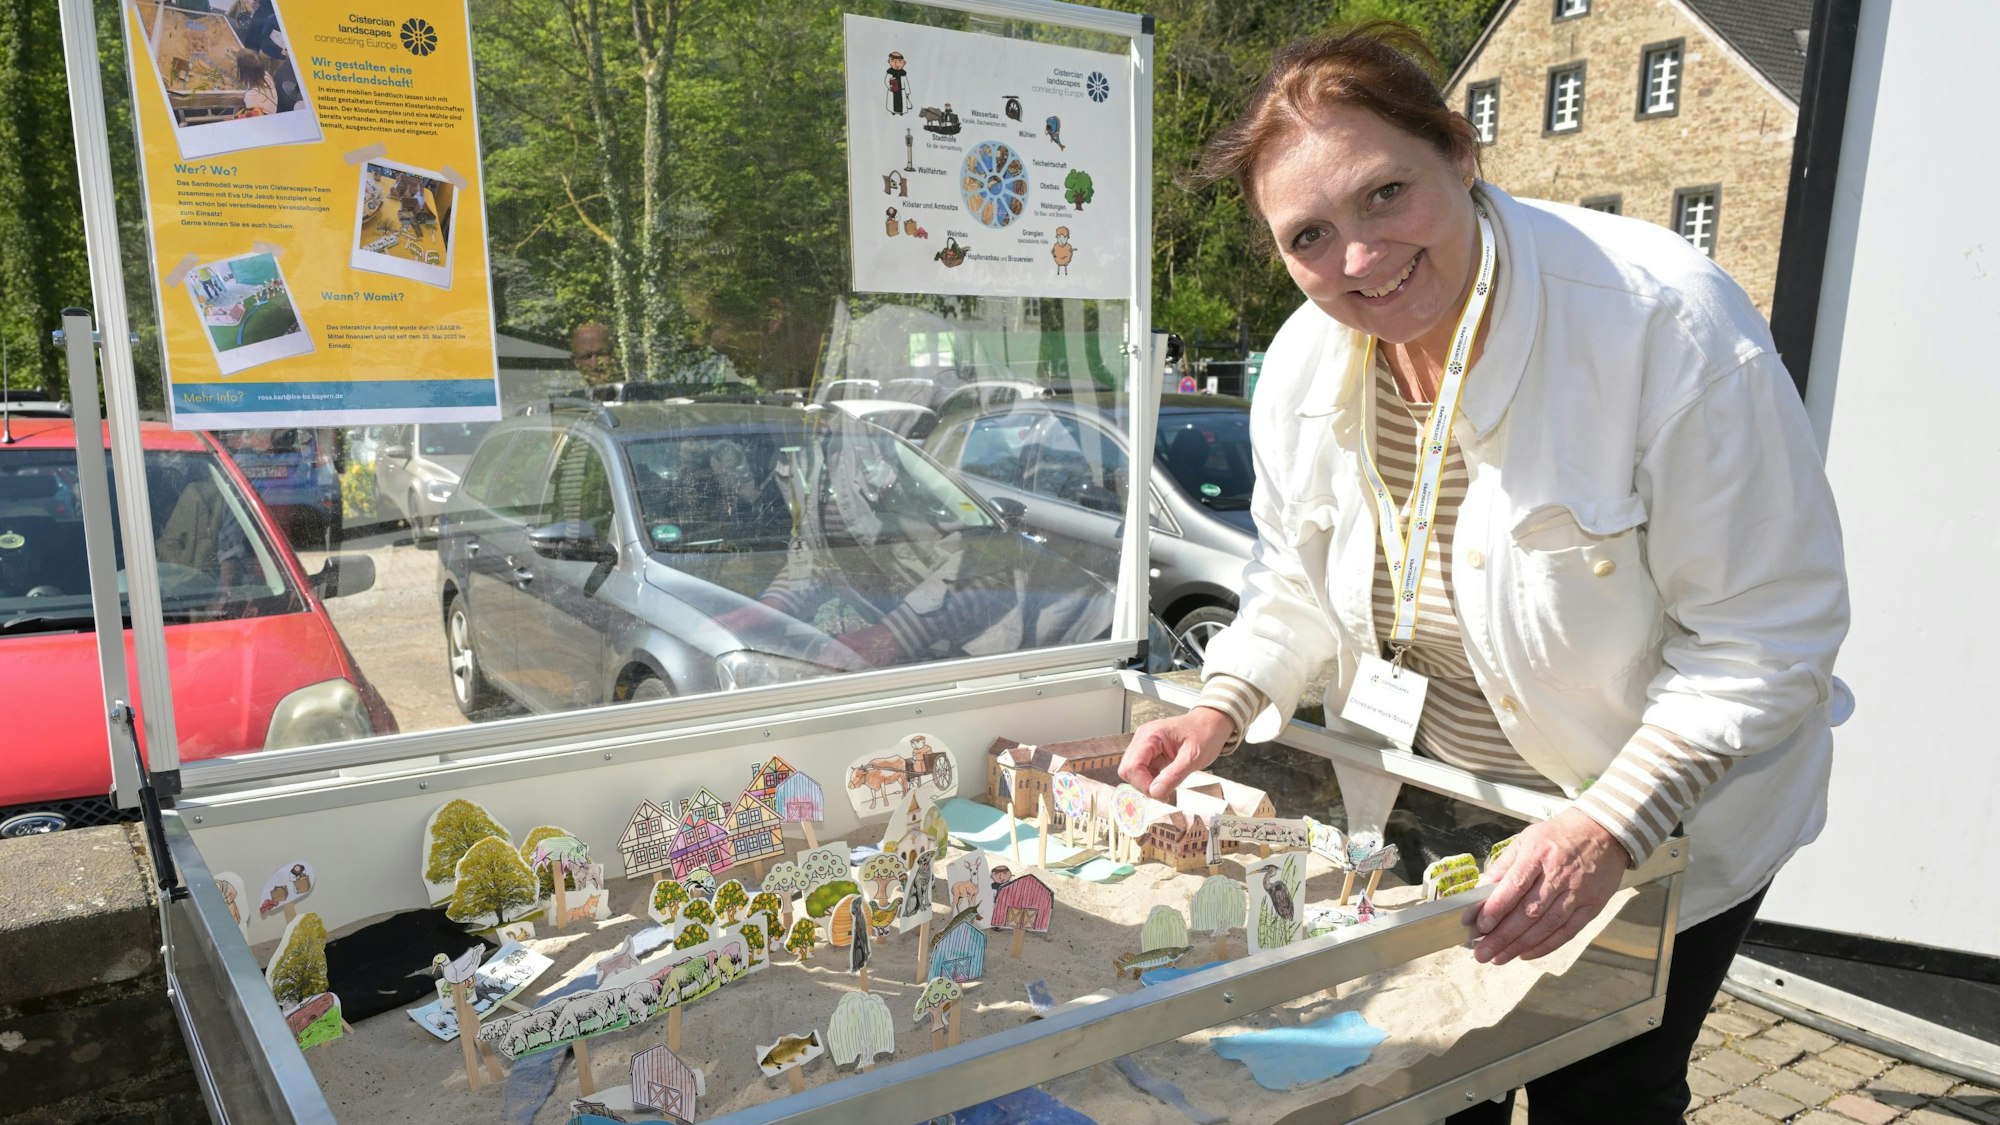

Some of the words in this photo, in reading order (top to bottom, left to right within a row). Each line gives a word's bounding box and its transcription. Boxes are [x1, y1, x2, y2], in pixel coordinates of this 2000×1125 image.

[348, 14, 395, 27] Cistercian
[339, 24, 392, 38] landscapes
[315, 34, 364, 48] connecting
[367, 38, 397, 50] Europe
[311, 56, 331, 67] Wir
[335, 60, 386, 72] gestalten
[390, 66, 412, 74] eine
[1054, 68, 1083, 79] Cistercian
[313, 71, 413, 88] Klosterlandschaft!
[1047, 77, 1081, 88] landscapes
[1032, 85, 1063, 97] connecting
[1065, 88, 1084, 98] Europe
[354, 107, 401, 116] Klosterkomplex
[405, 103, 464, 112] Klosterlandschaften
[971, 109, 998, 119] Wasserbau
[346, 124, 392, 132] ausgeschnitten
[1019, 130, 1036, 138] Mühlen
[1032, 159, 1067, 169] Teichwirtschaft
[174, 164, 206, 174] Wer?
[210, 166, 238, 176] Wo?
[918, 166, 947, 176] Wallfahrten
[270, 184, 331, 193] Cisterscapes-Team
[934, 203, 958, 211] Amtssitze
[1040, 202, 1066, 211] Waldungen
[968, 252, 1000, 263] Hopfenanbau
[1482, 246, 1490, 281] CISTERSCAPES
[321, 291, 360, 301] Wann?
[363, 292, 405, 301] Womit?
[1453, 326, 1467, 360] CISTERSCAPES
[184, 391, 214, 403] Mehr
[1433, 405, 1446, 440] CISTERSCAPES
[1418, 482, 1428, 517] CISTERSCAPES
[1405, 558, 1415, 589] CISTERSCAPES
[16, 822, 52, 836] Ford
